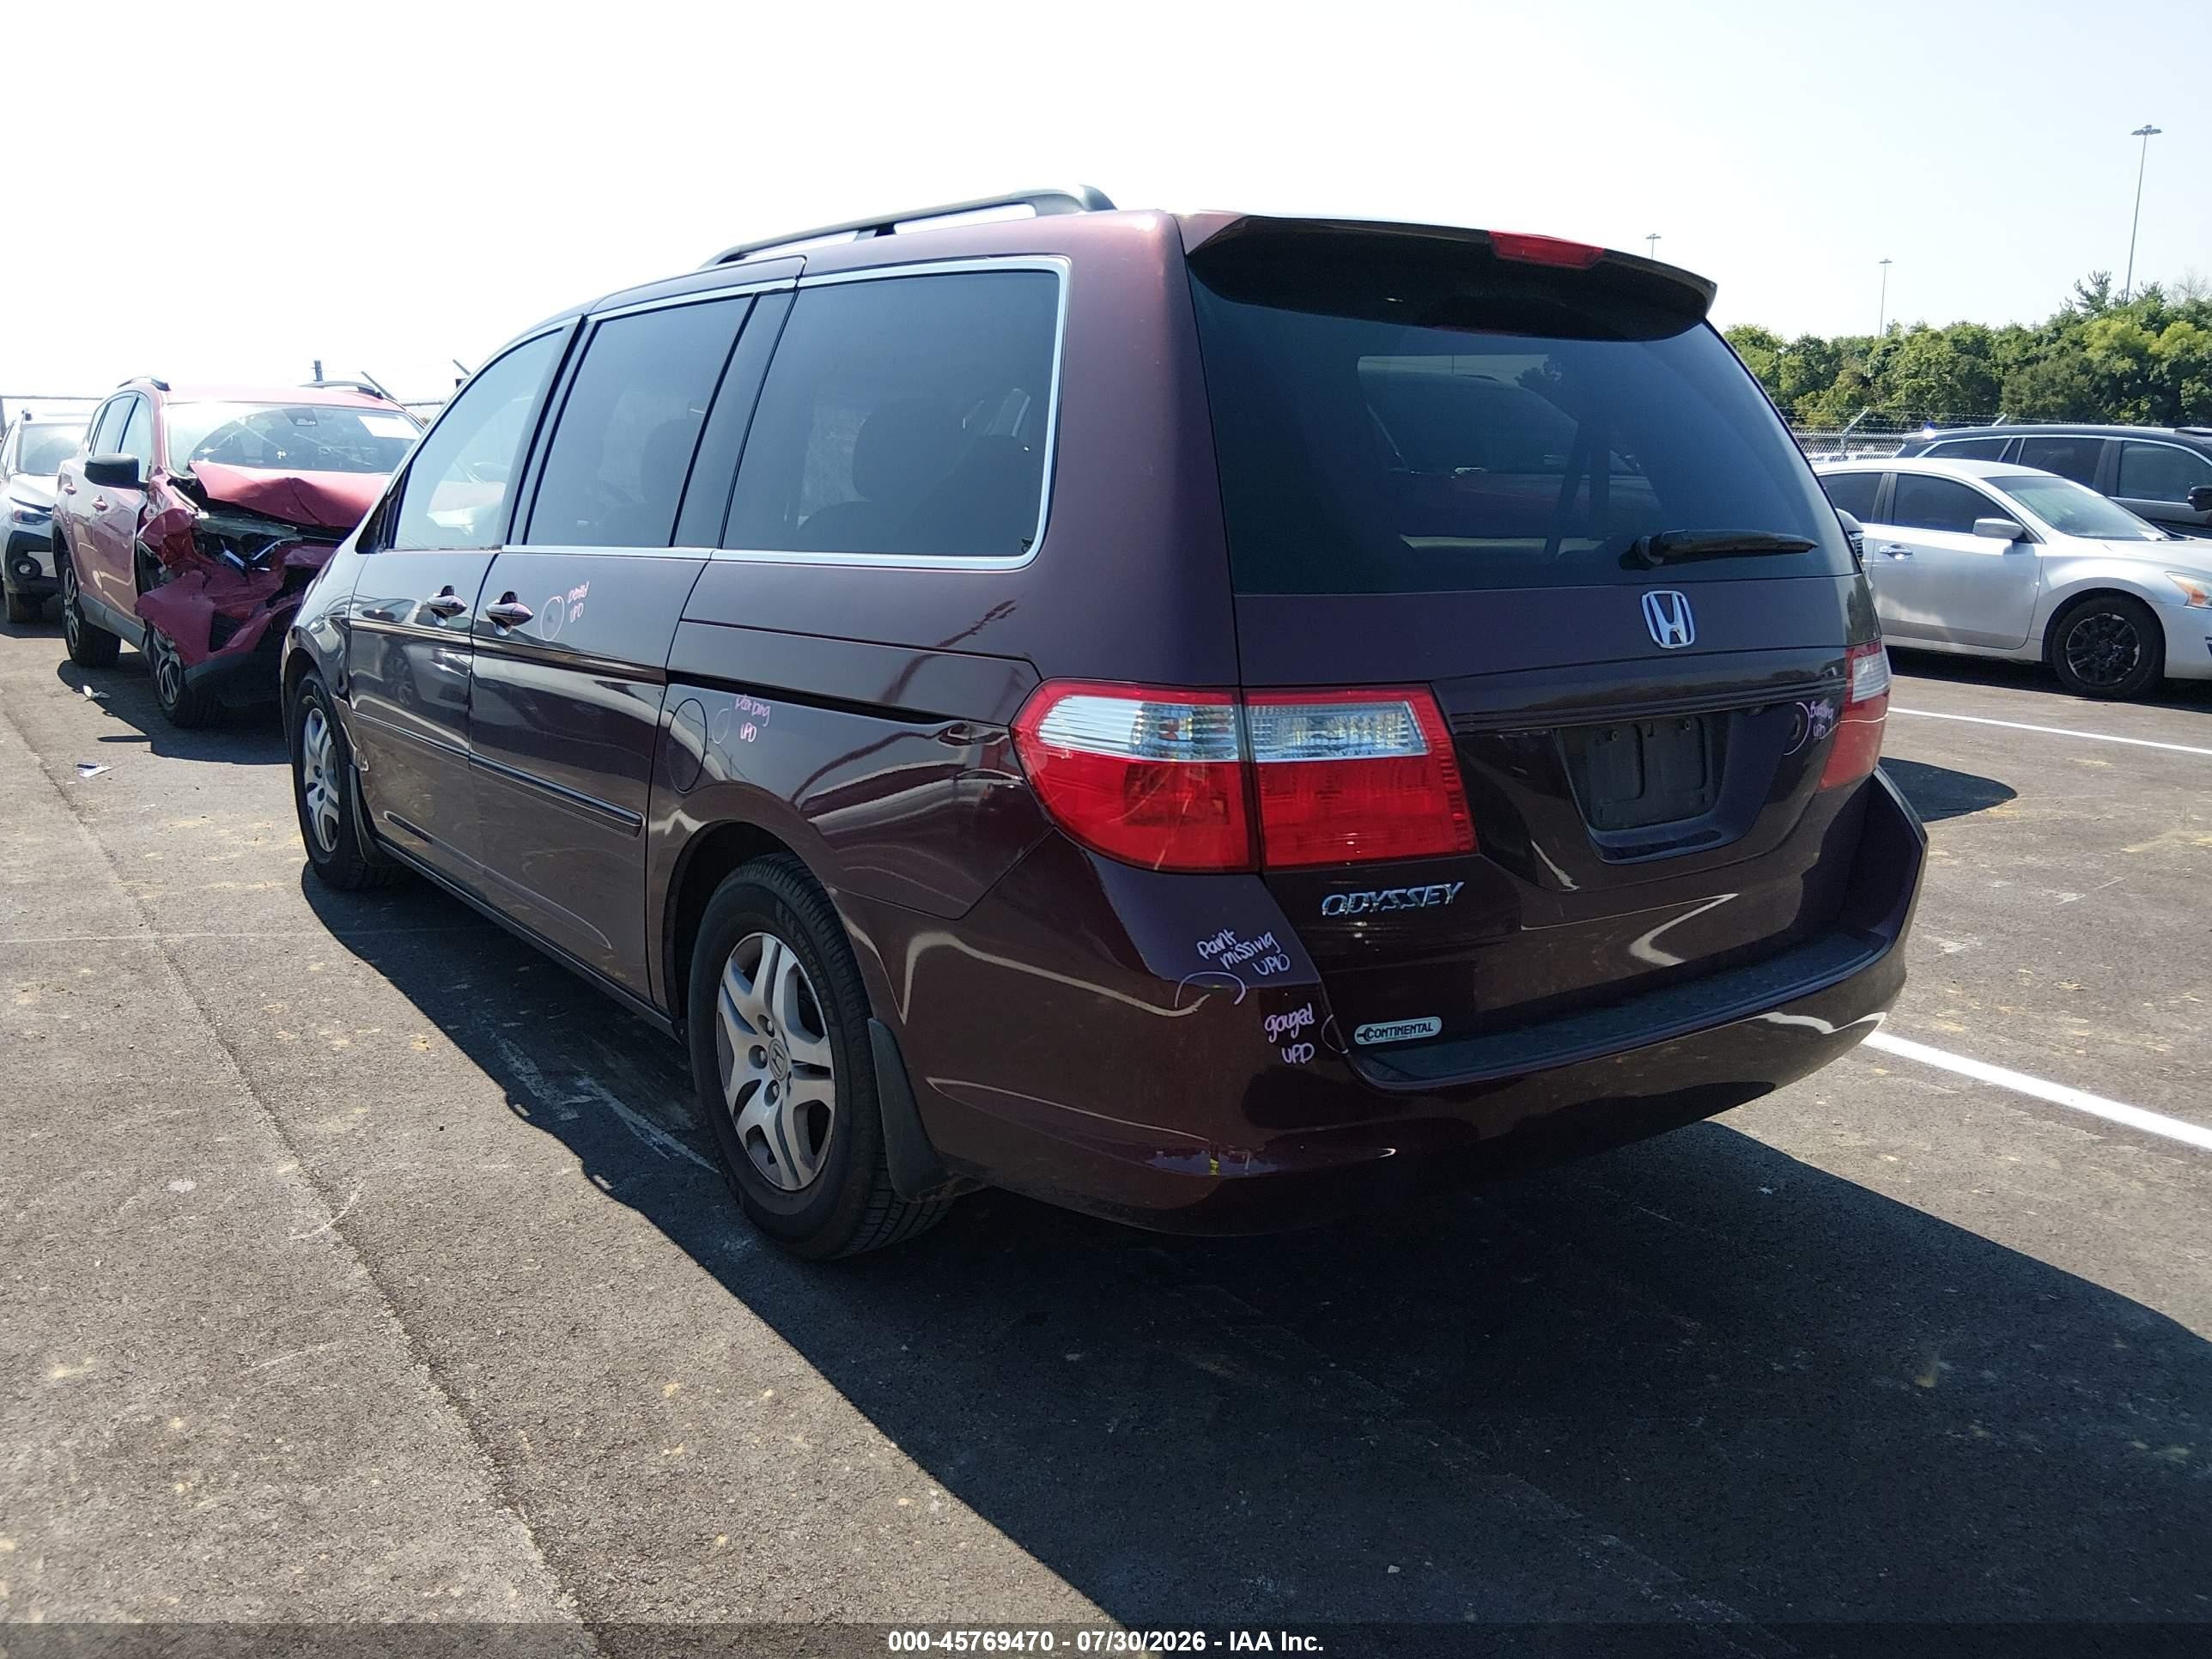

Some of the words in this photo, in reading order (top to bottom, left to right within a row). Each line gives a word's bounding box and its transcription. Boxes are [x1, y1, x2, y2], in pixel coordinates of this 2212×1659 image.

[1321, 881, 1465, 916] ODYSSEY
[1219, 931, 1281, 969] missing
[1252, 953, 1291, 975] UPD
[1264, 1002, 1316, 1043] gouged
[1364, 1022, 1434, 1042] CONTINENTAL
[1281, 1042, 1316, 1064] UPD
